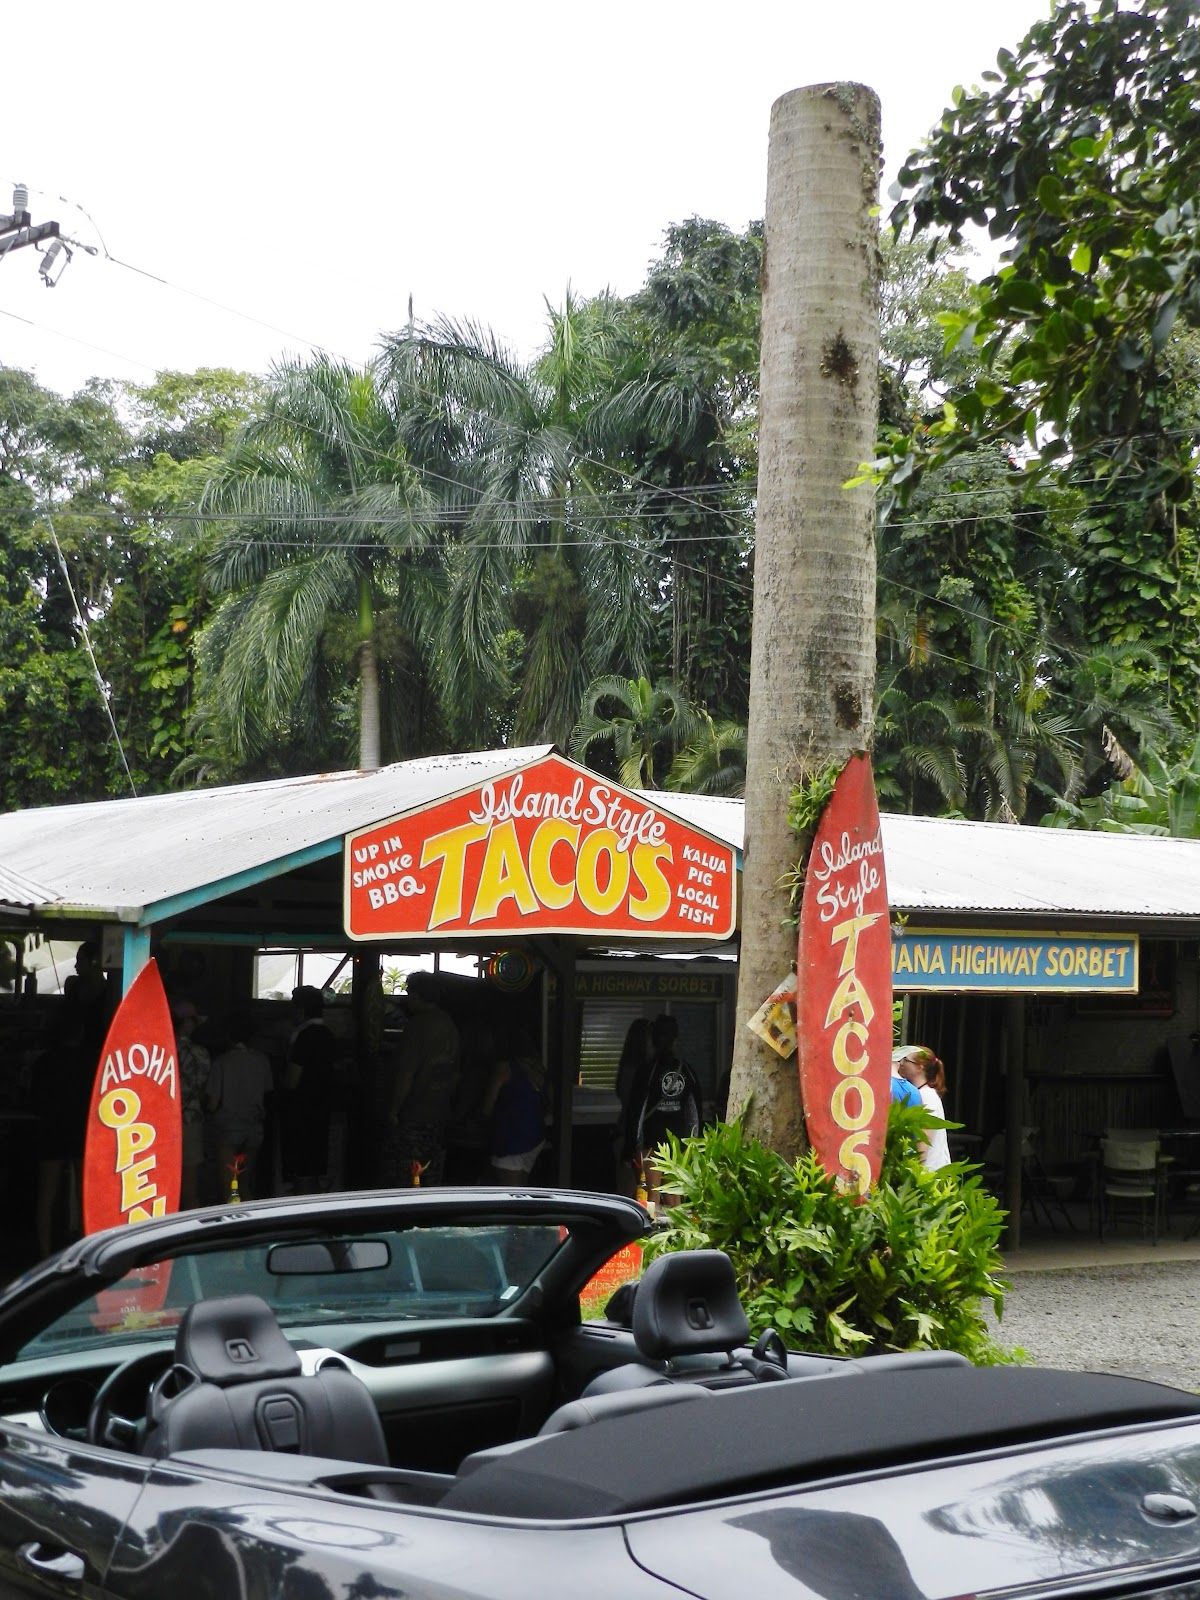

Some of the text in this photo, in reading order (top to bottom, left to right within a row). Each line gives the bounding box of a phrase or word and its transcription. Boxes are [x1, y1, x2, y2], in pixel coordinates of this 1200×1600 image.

[469, 774, 666, 853] Island Style
[354, 836, 403, 863] UP IN
[682, 845, 727, 873] KALUA
[419, 818, 674, 931] TACOS
[688, 866, 713, 886] PIG
[814, 826, 883, 922] Island Style
[368, 875, 426, 910] BBQ
[677, 884, 720, 910] LOCAL
[679, 903, 715, 926] FISH
[950, 944, 1043, 977] HIGHWAY
[1044, 945, 1130, 979] SORBET
[591, 975, 652, 992] HIGHWAY
[658, 975, 720, 993] SORBET
[100, 1043, 176, 1099] ALOHA
[824, 912, 885, 1196] TACOS
